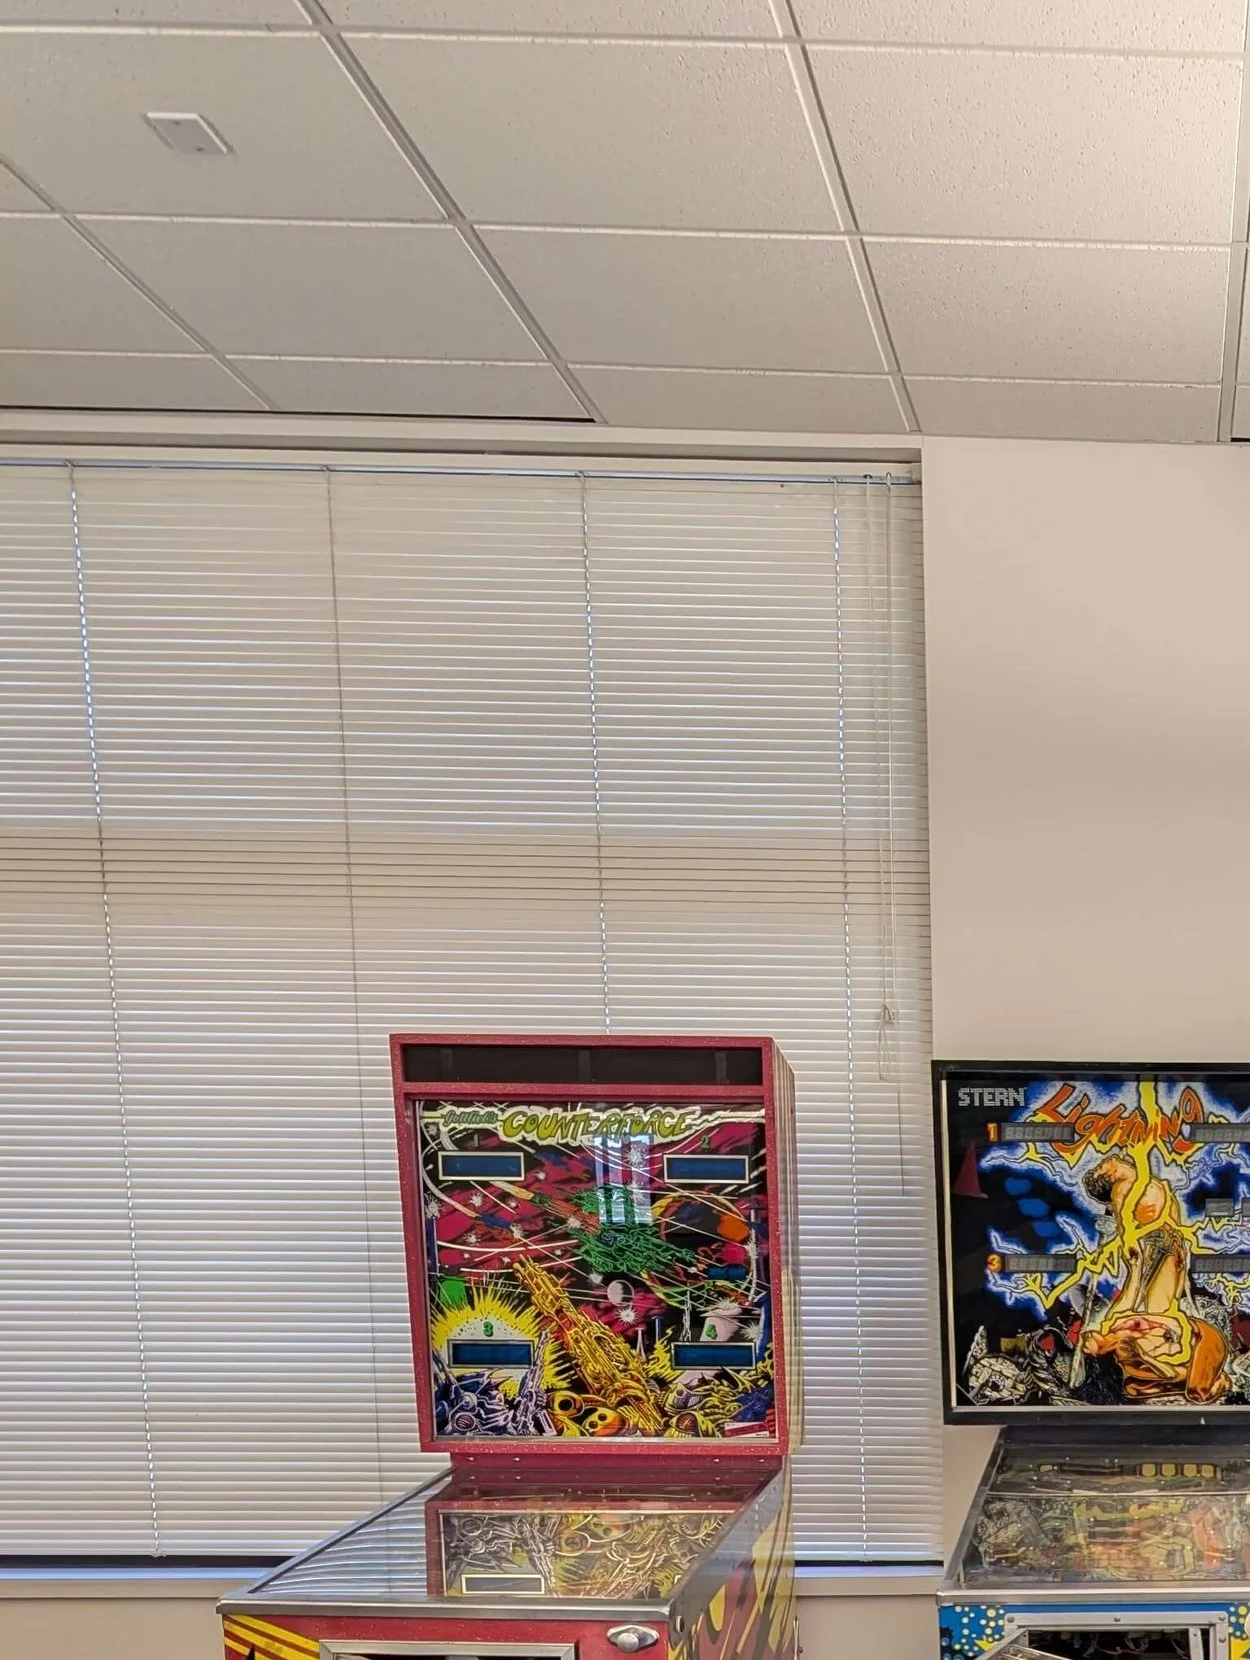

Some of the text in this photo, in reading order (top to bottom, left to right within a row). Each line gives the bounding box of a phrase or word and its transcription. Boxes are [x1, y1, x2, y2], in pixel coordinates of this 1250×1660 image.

[958, 1087, 1025, 1107] STERN
[987, 1123, 998, 1141] 1
[701, 1136, 710, 1149] 2
[483, 1321, 494, 1337] 3
[706, 1324, 718, 1340] 4
